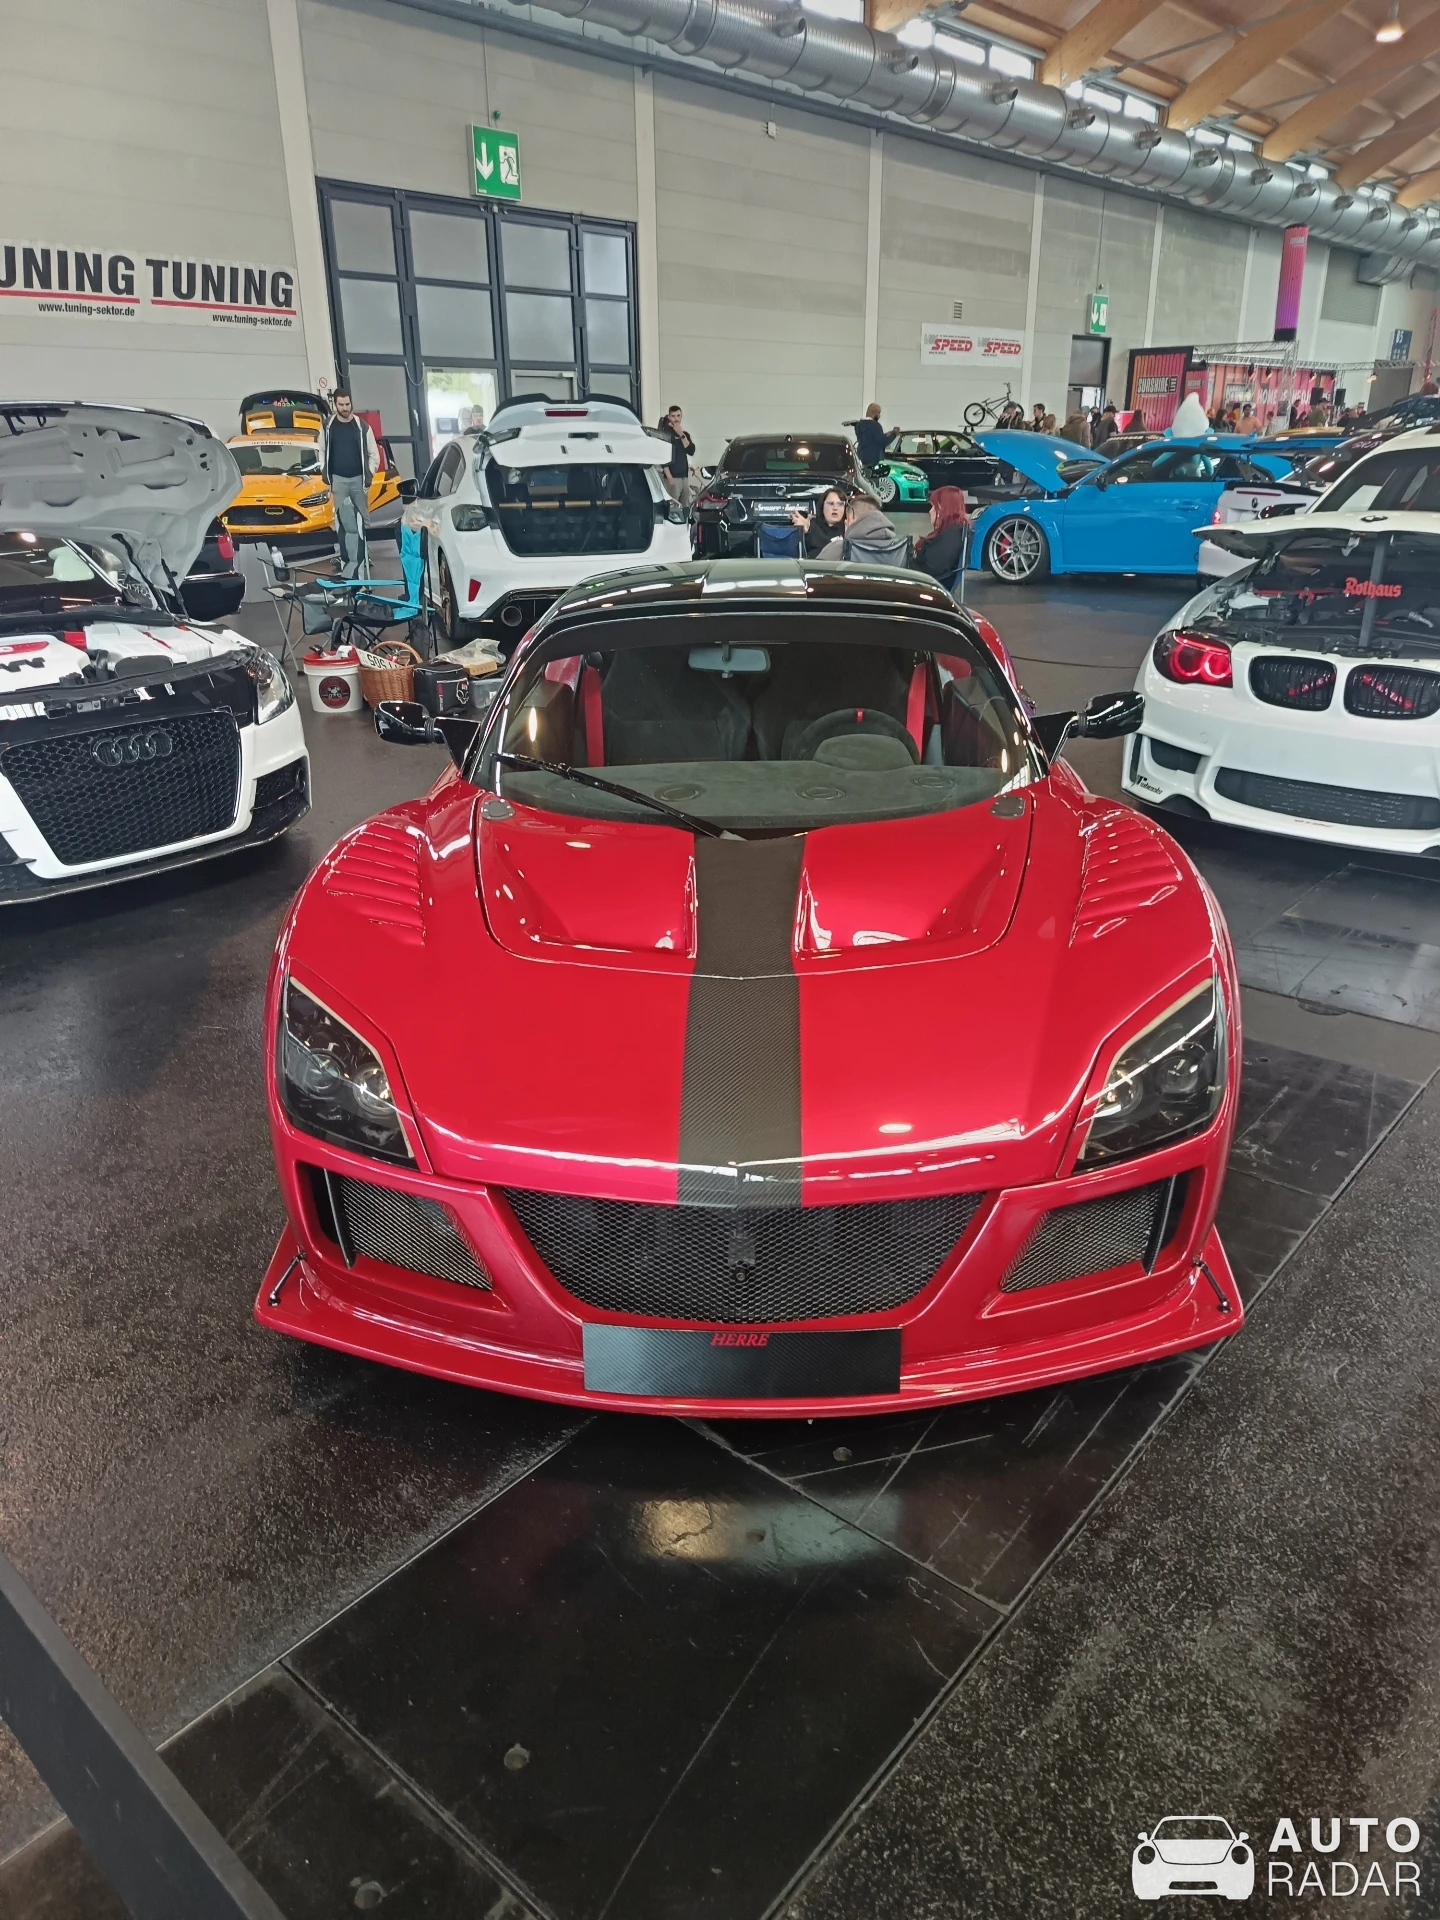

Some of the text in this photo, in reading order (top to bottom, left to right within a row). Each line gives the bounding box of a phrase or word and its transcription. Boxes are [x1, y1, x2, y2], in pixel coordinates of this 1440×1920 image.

[0, 245, 135, 296] UNING
[146, 258, 294, 308] TUNING
[38, 302, 135, 316] www.tuning-sektor.de
[212, 314, 292, 327] www.tuning-sektor.de
[931, 338, 973, 352] SPEED
[983, 341, 1022, 355] SPEED
[1343, 576, 1402, 598] Rothaus
[710, 1333, 770, 1347] HERRE
